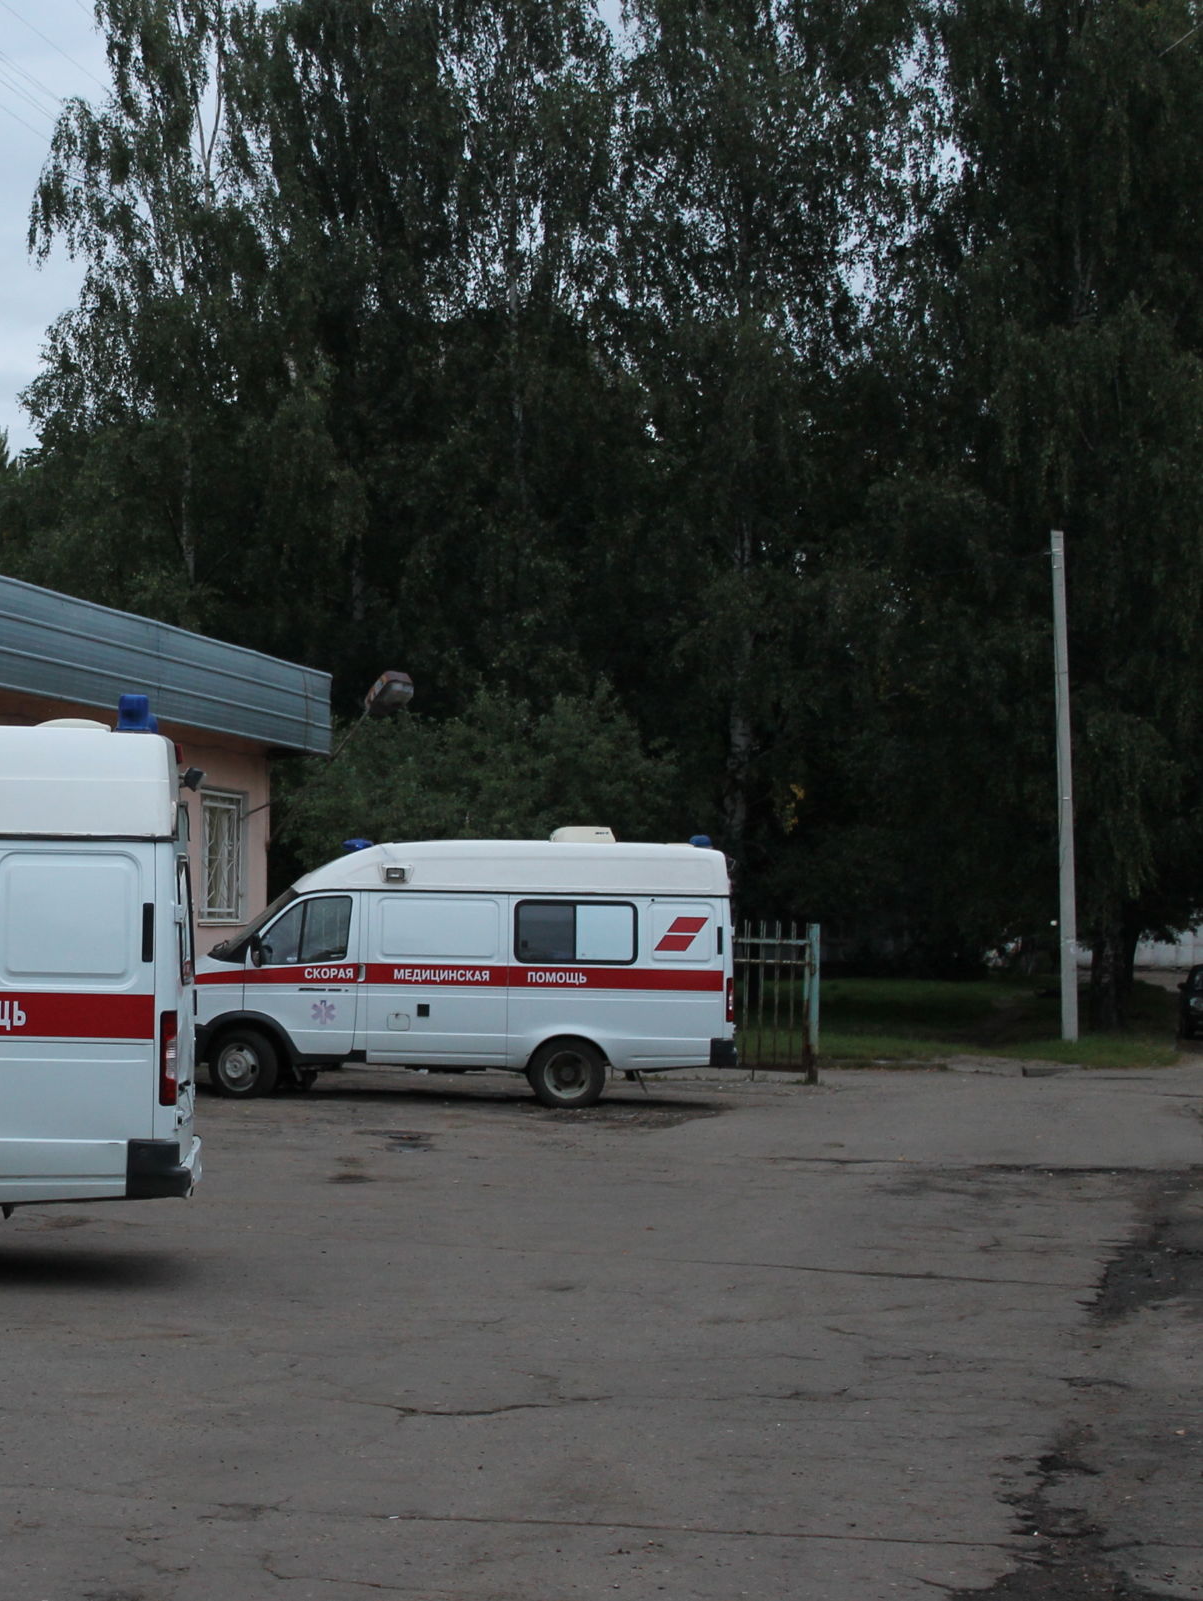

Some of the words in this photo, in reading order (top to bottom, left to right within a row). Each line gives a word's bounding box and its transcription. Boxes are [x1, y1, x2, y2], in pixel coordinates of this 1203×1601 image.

[304, 968, 354, 980] СКОРАЯ
[393, 969, 490, 983] МЕДИЦИНСКАЯ
[527, 971, 587, 984] ПОМОЩЬ
